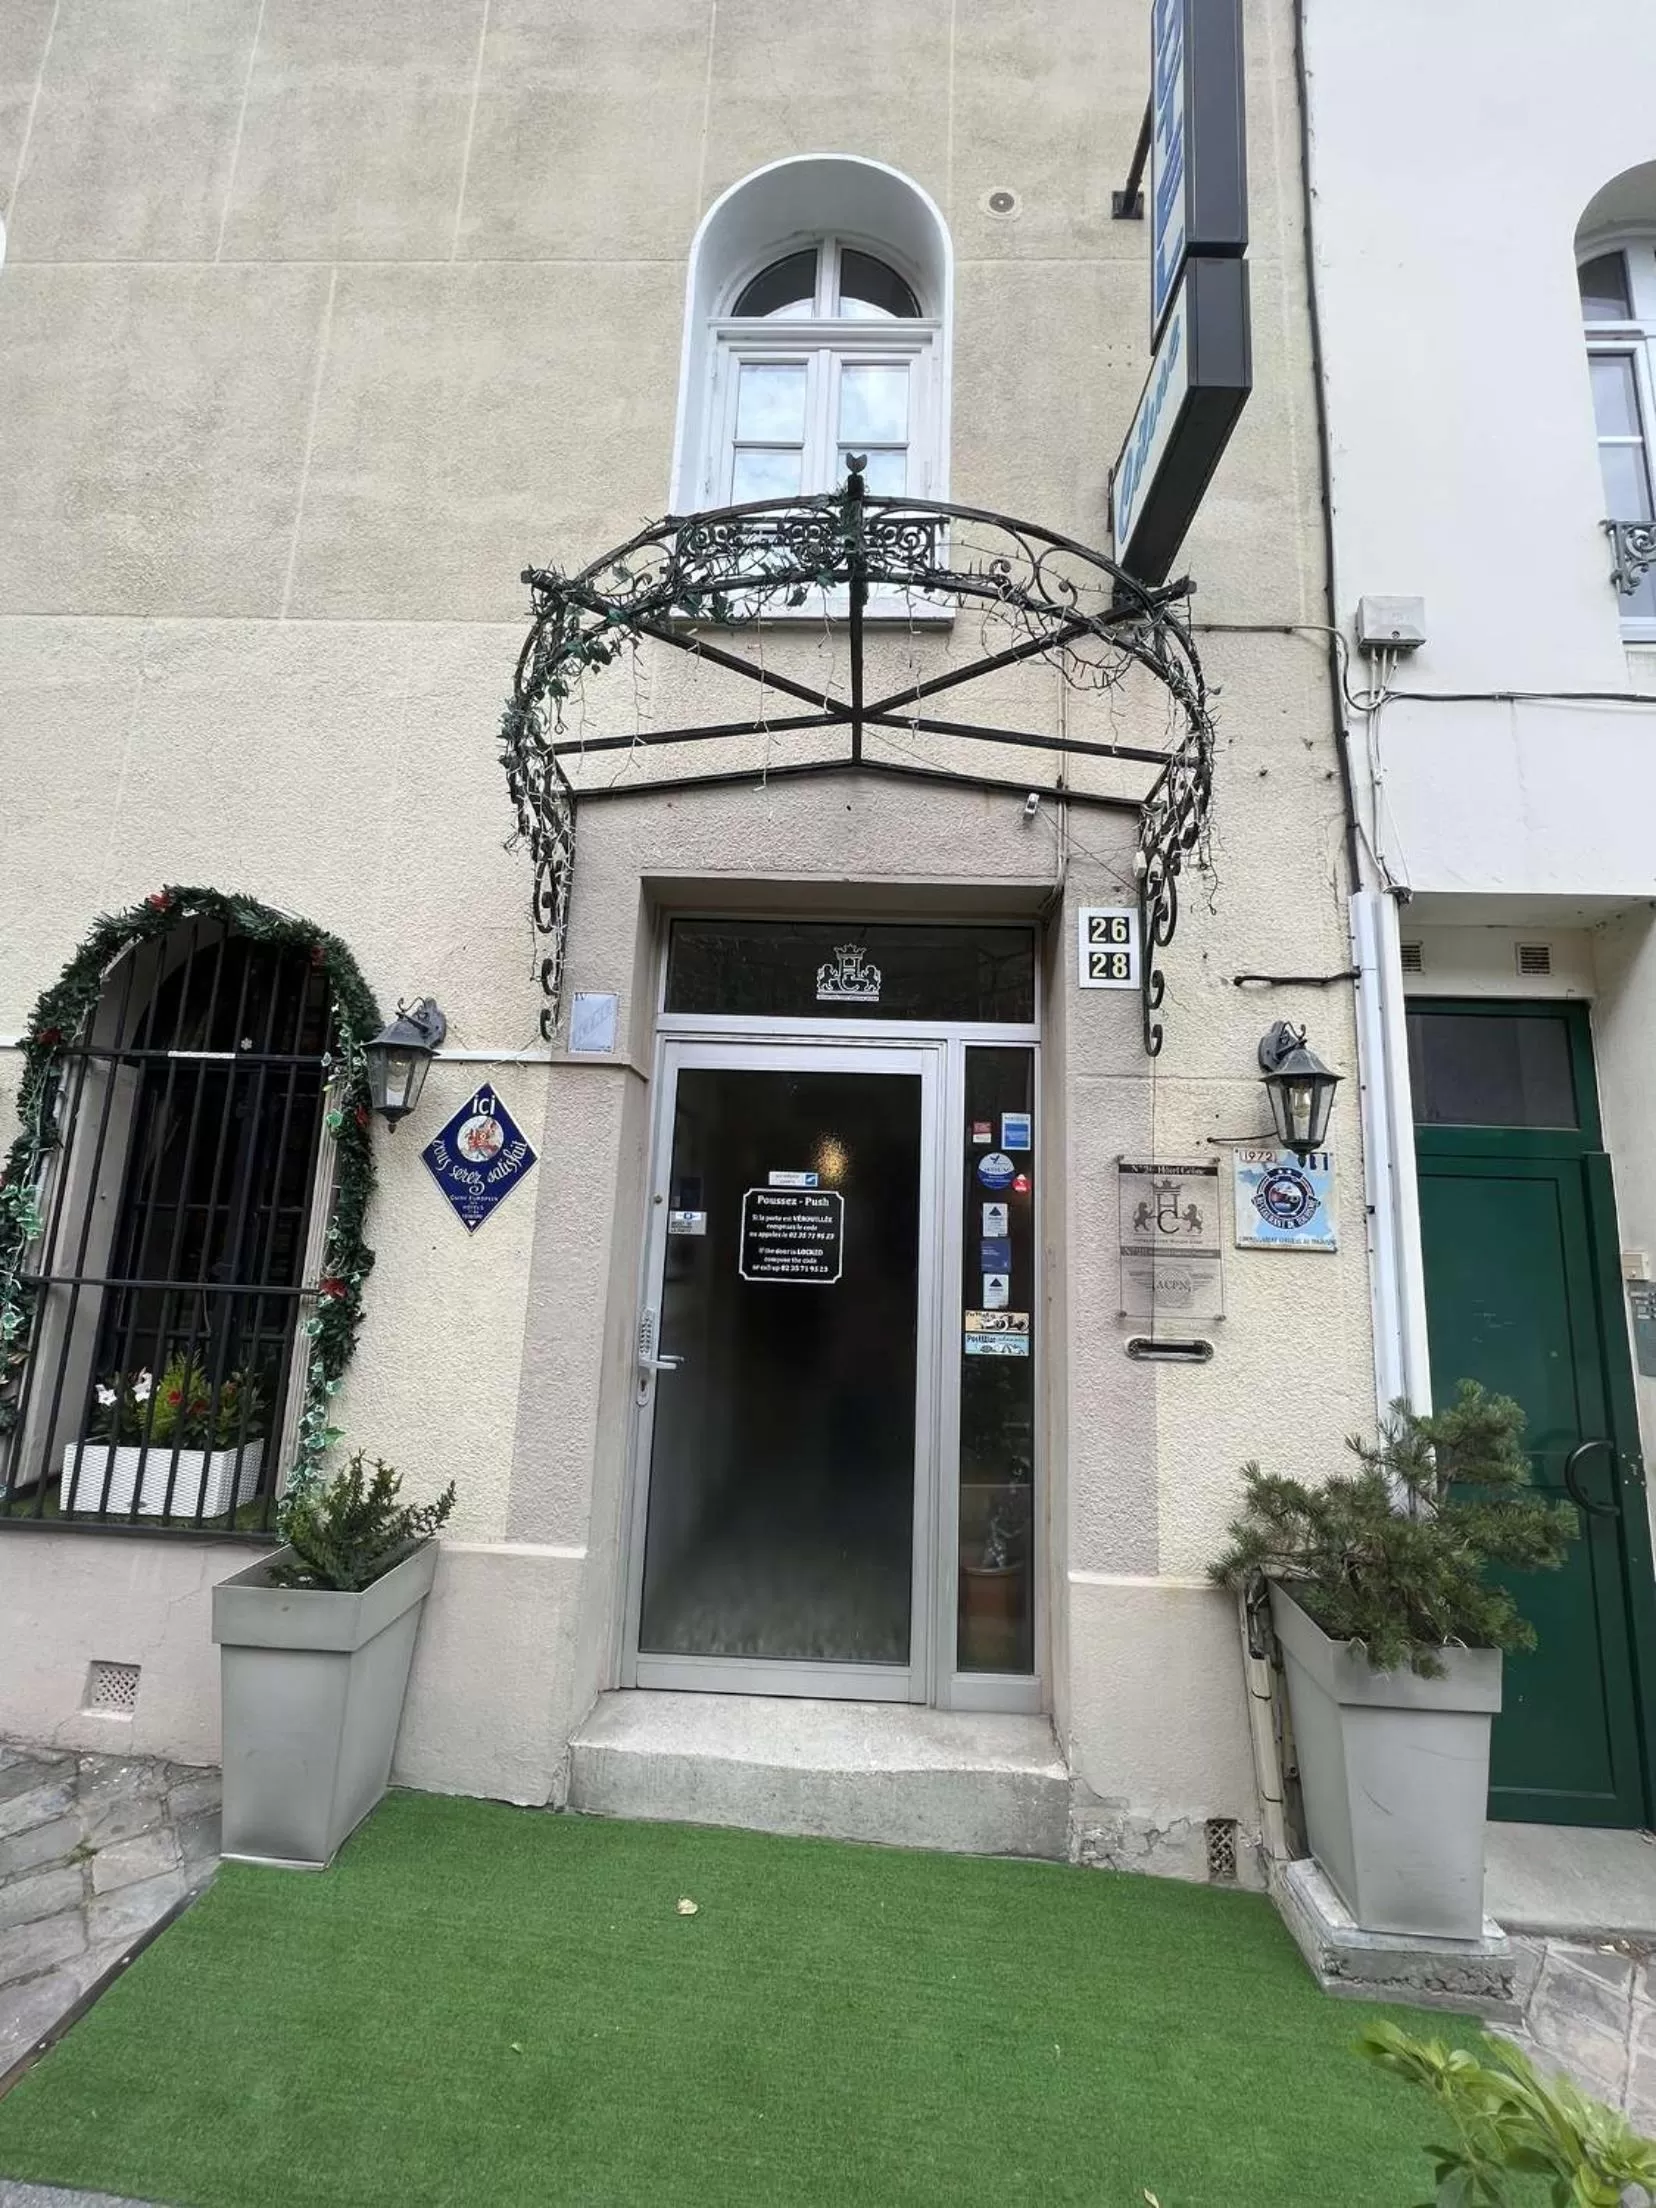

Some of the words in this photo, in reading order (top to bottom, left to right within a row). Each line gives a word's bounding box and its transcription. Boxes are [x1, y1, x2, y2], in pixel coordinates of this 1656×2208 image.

[1091, 918, 1127, 943] 26
[1091, 953, 1128, 978] 28
[472, 1094, 496, 1115] ici
[1243, 1151, 1273, 1161] 1972
[432, 1139, 453, 1171] vous
[448, 1165, 485, 1196] serez
[487, 1140, 528, 1183] satisfait
[757, 1195, 798, 1206] Poussez
[804, 1196, 830, 1207] Push
[797, 1248, 824, 1256] LOCKED
